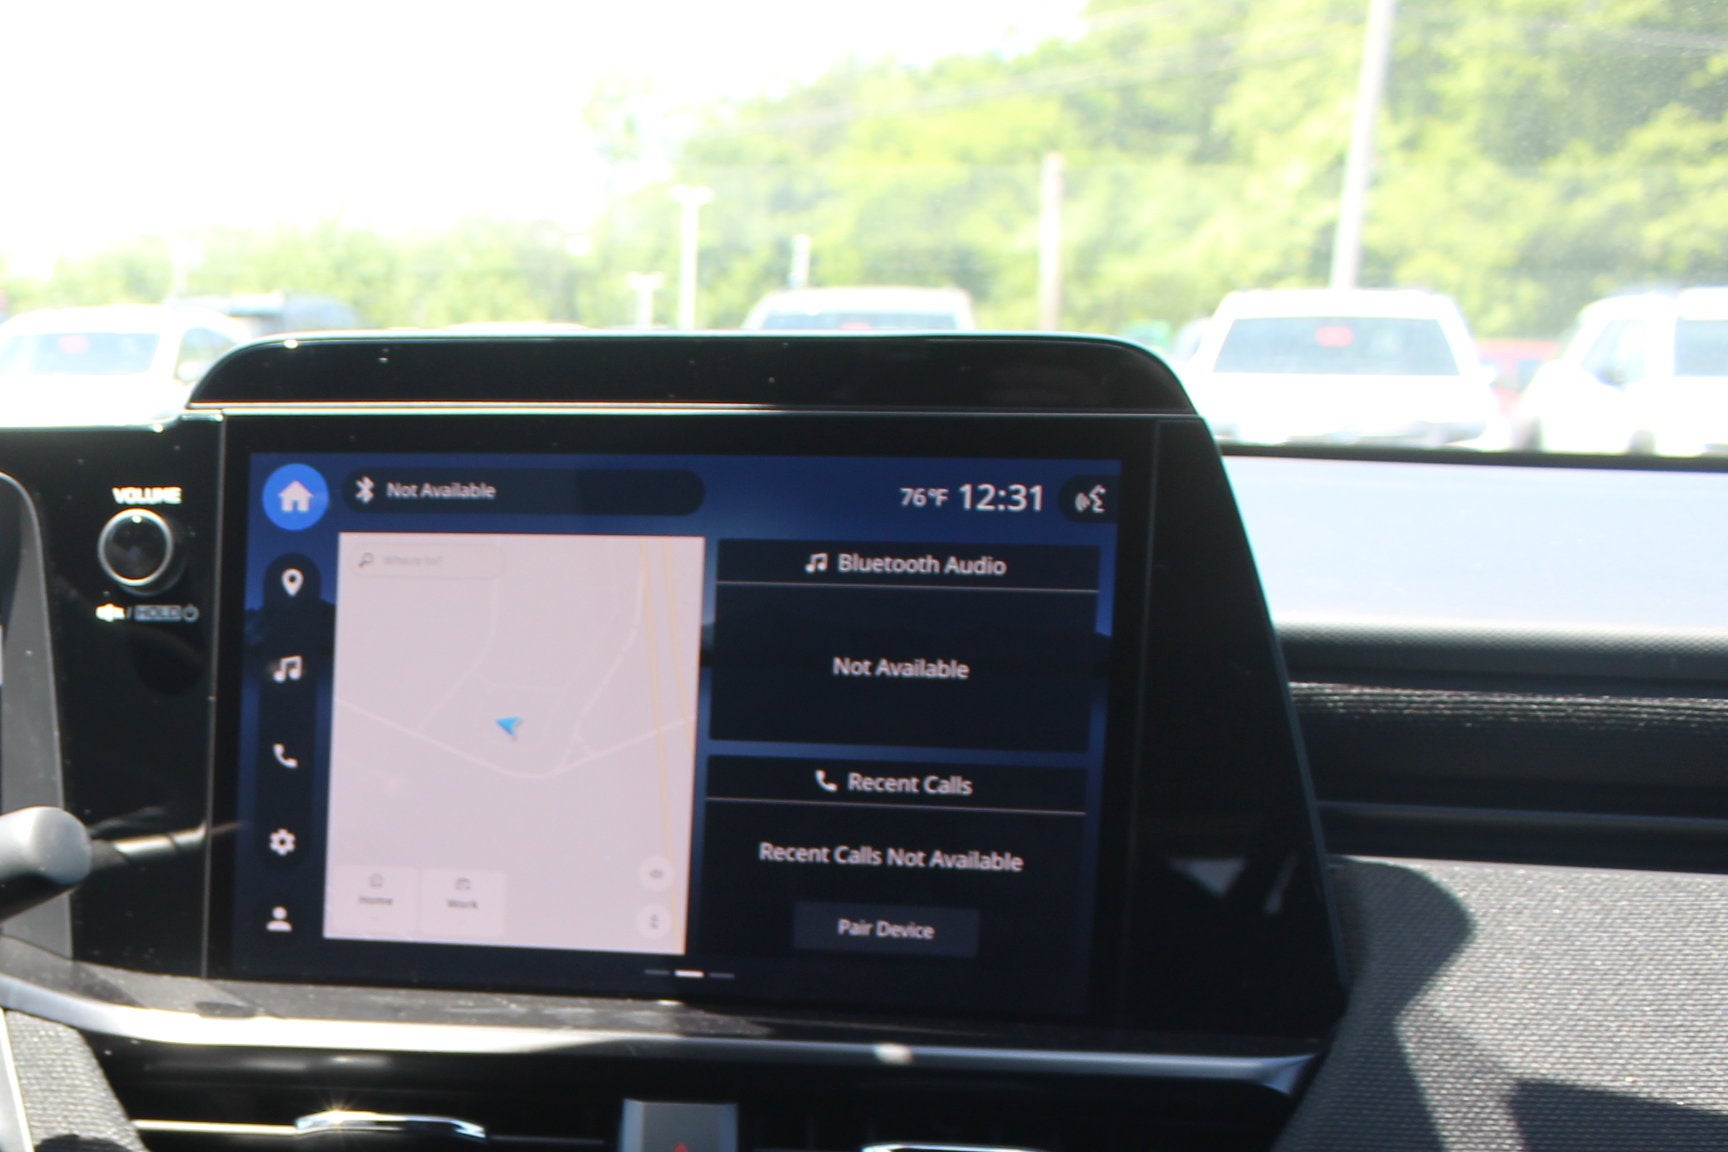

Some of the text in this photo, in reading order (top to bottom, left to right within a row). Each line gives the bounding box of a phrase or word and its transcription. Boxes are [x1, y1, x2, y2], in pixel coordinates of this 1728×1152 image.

[112, 486, 183, 505] VOLUME
[387, 481, 496, 500] Not Available
[959, 483, 1043, 512] 12:31
[838, 553, 1007, 575] Bluetooth Audio
[833, 656, 970, 679] Not Available
[848, 772, 973, 795] Recent Calls
[759, 842, 1024, 872] Recent Calls Not Available
[837, 919, 934, 940] Pair Device
